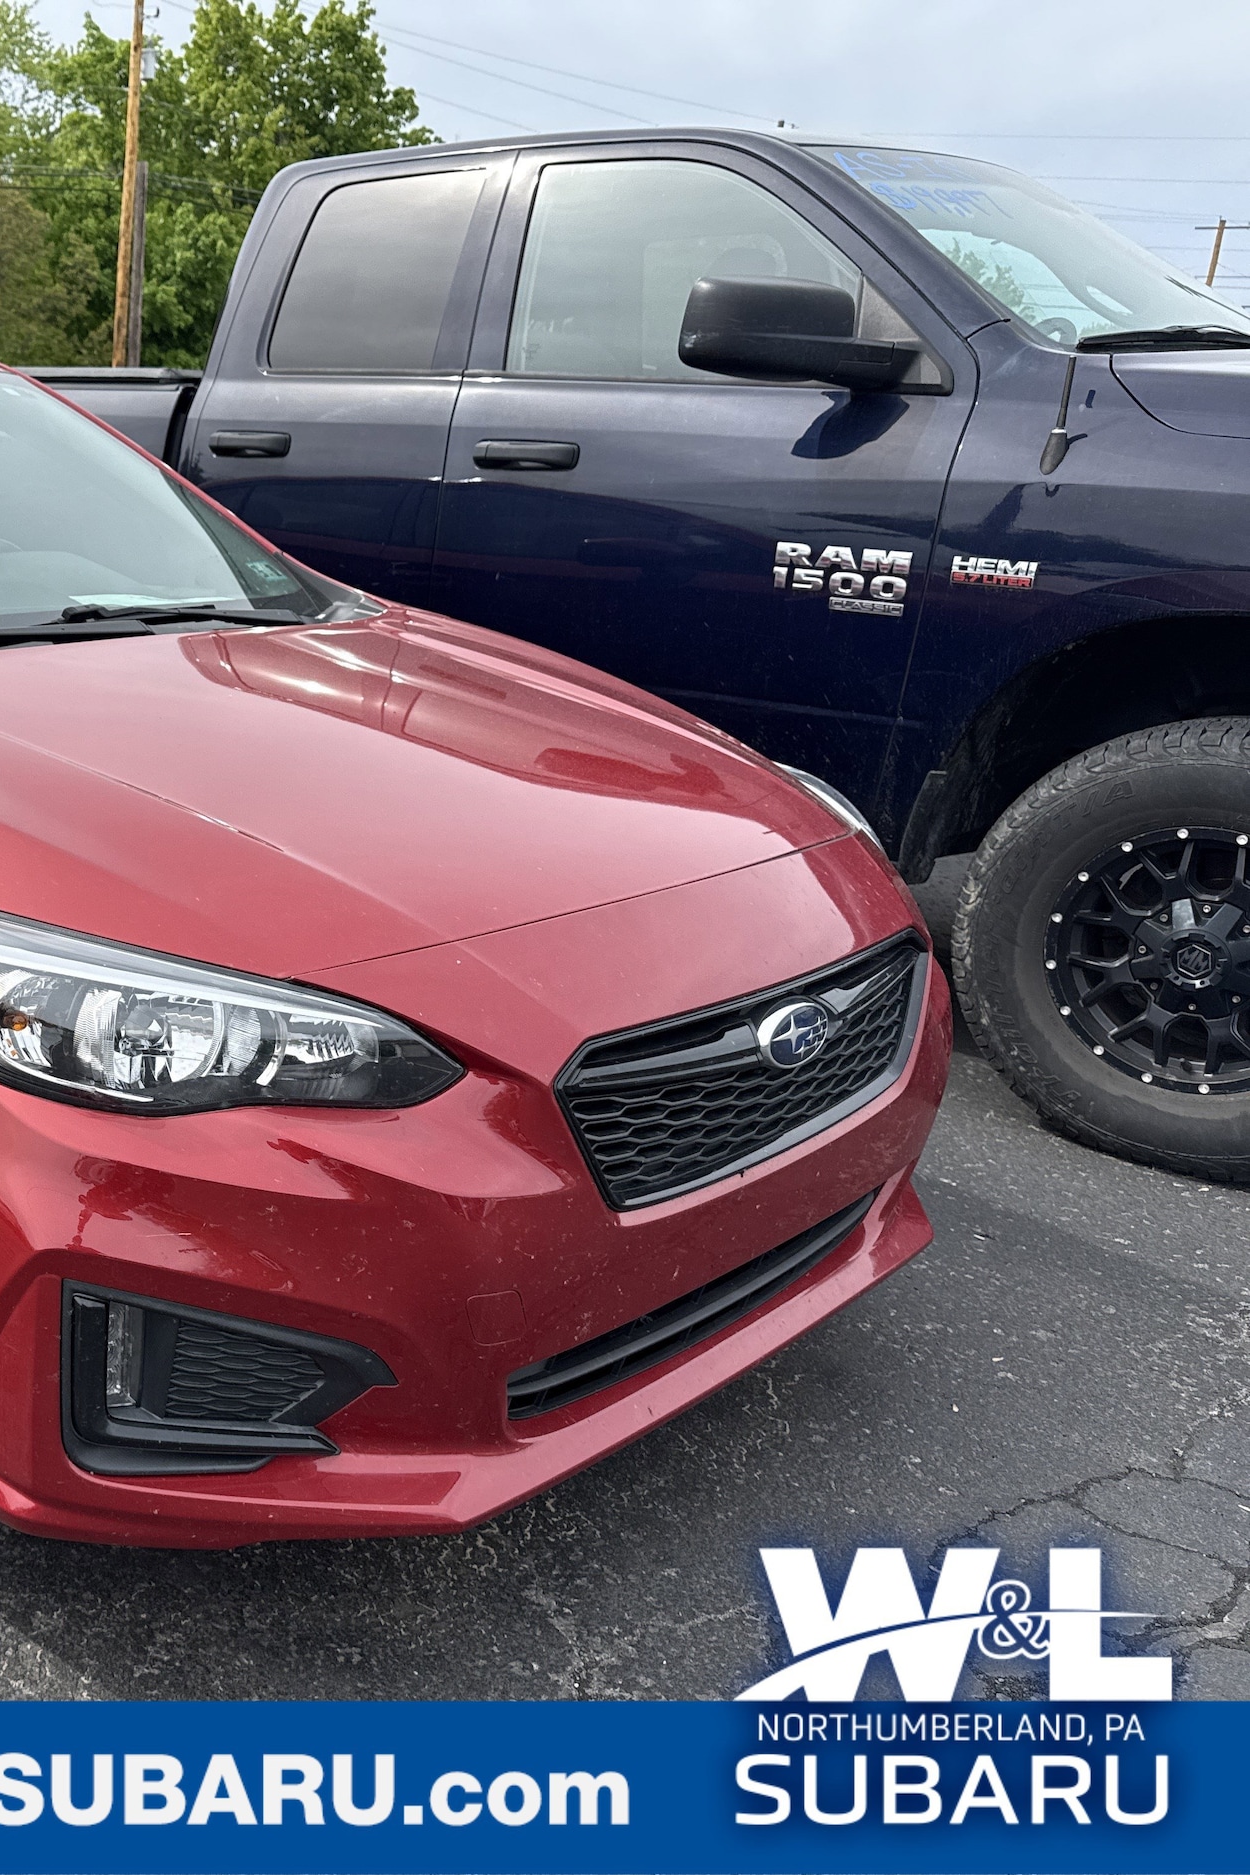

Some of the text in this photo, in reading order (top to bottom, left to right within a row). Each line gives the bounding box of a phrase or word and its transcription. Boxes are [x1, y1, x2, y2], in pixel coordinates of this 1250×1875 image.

[775, 541, 913, 574] RAM
[951, 555, 1038, 576] HEMI
[773, 566, 908, 600] 1500
[952, 571, 1031, 588] 5.7 LITER
[830, 599, 902, 615] CLASSIC
